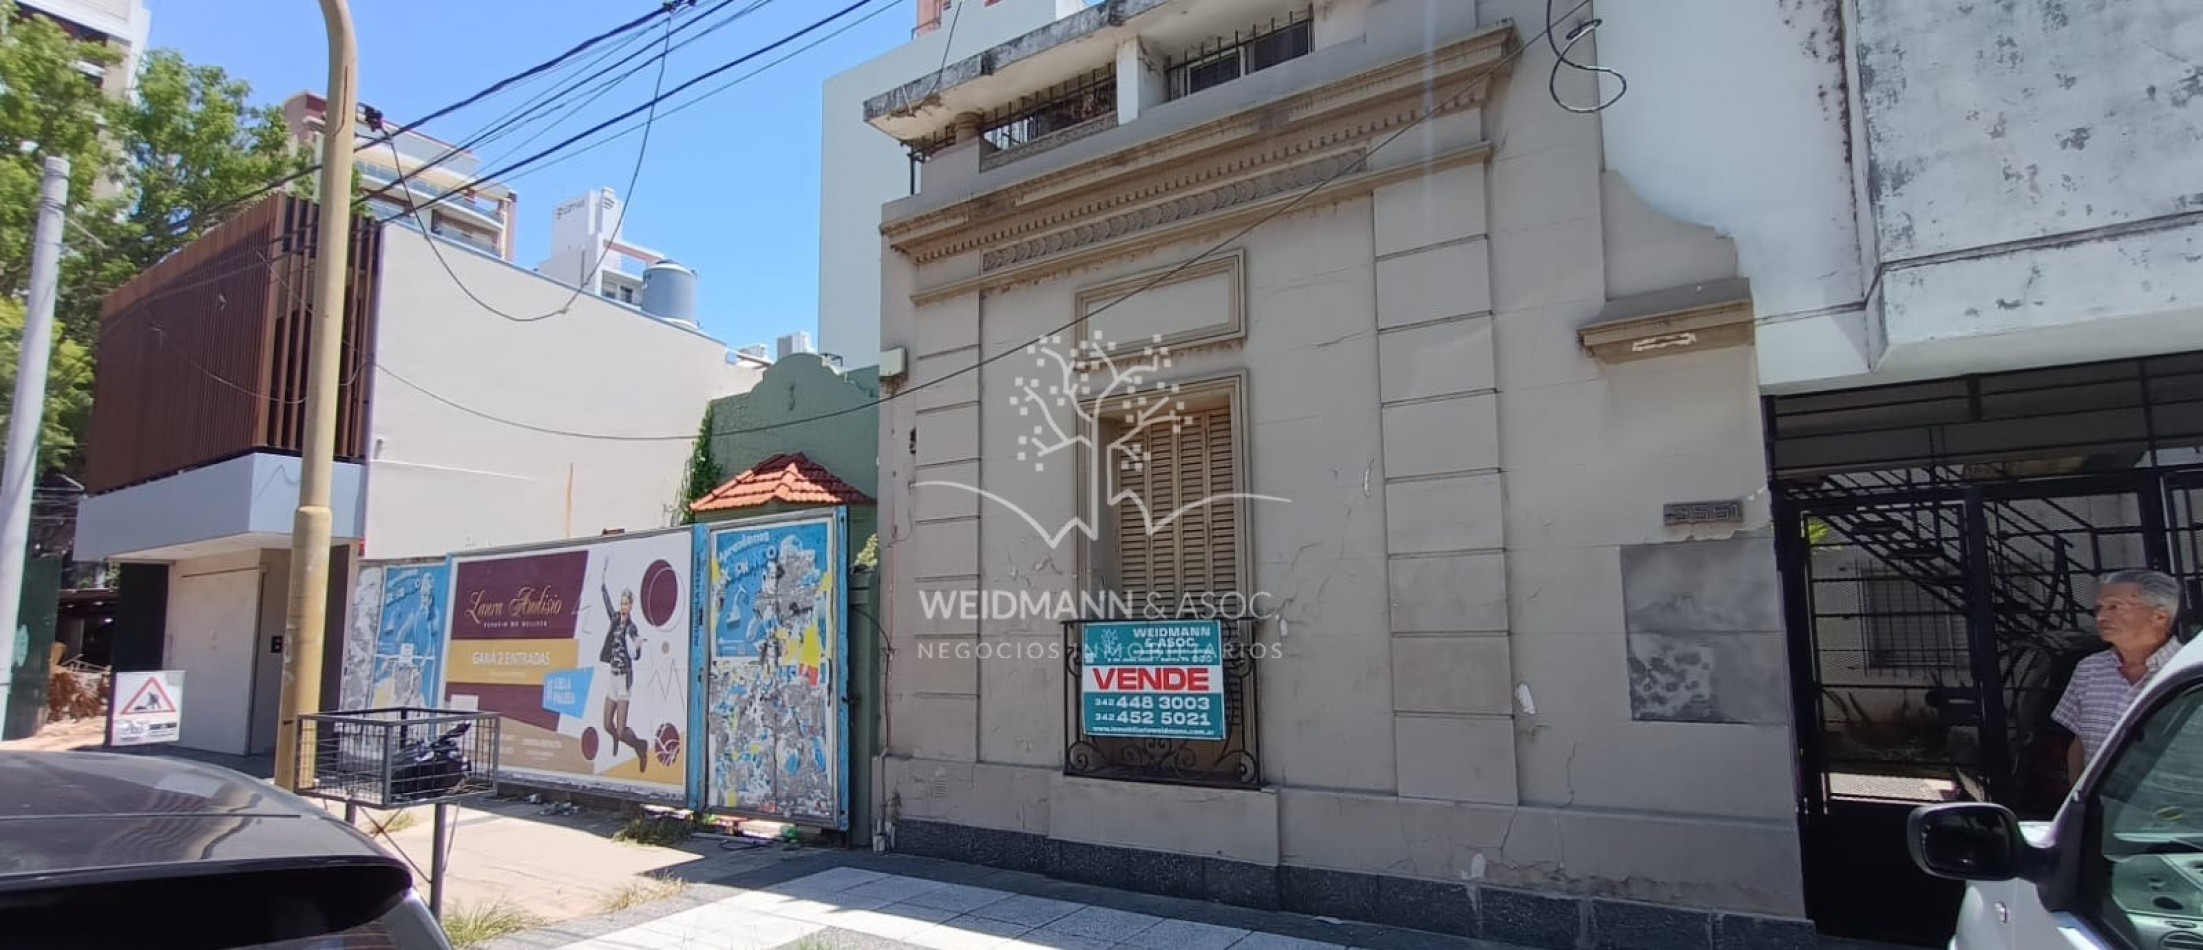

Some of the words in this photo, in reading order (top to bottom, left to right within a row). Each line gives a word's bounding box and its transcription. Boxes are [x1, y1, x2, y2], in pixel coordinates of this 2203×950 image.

[1133, 626, 1211, 638] WEIDMANN
[506, 651, 550, 666] ENTRADAS
[1093, 667, 1210, 691] VENDE
[1095, 698, 1115, 706] 342
[1116, 696, 1154, 709] 448
[1158, 696, 1210, 710] 3003
[1095, 712, 1115, 721] 342
[1116, 711, 1155, 724] 452
[1160, 711, 1211, 726] 5021
